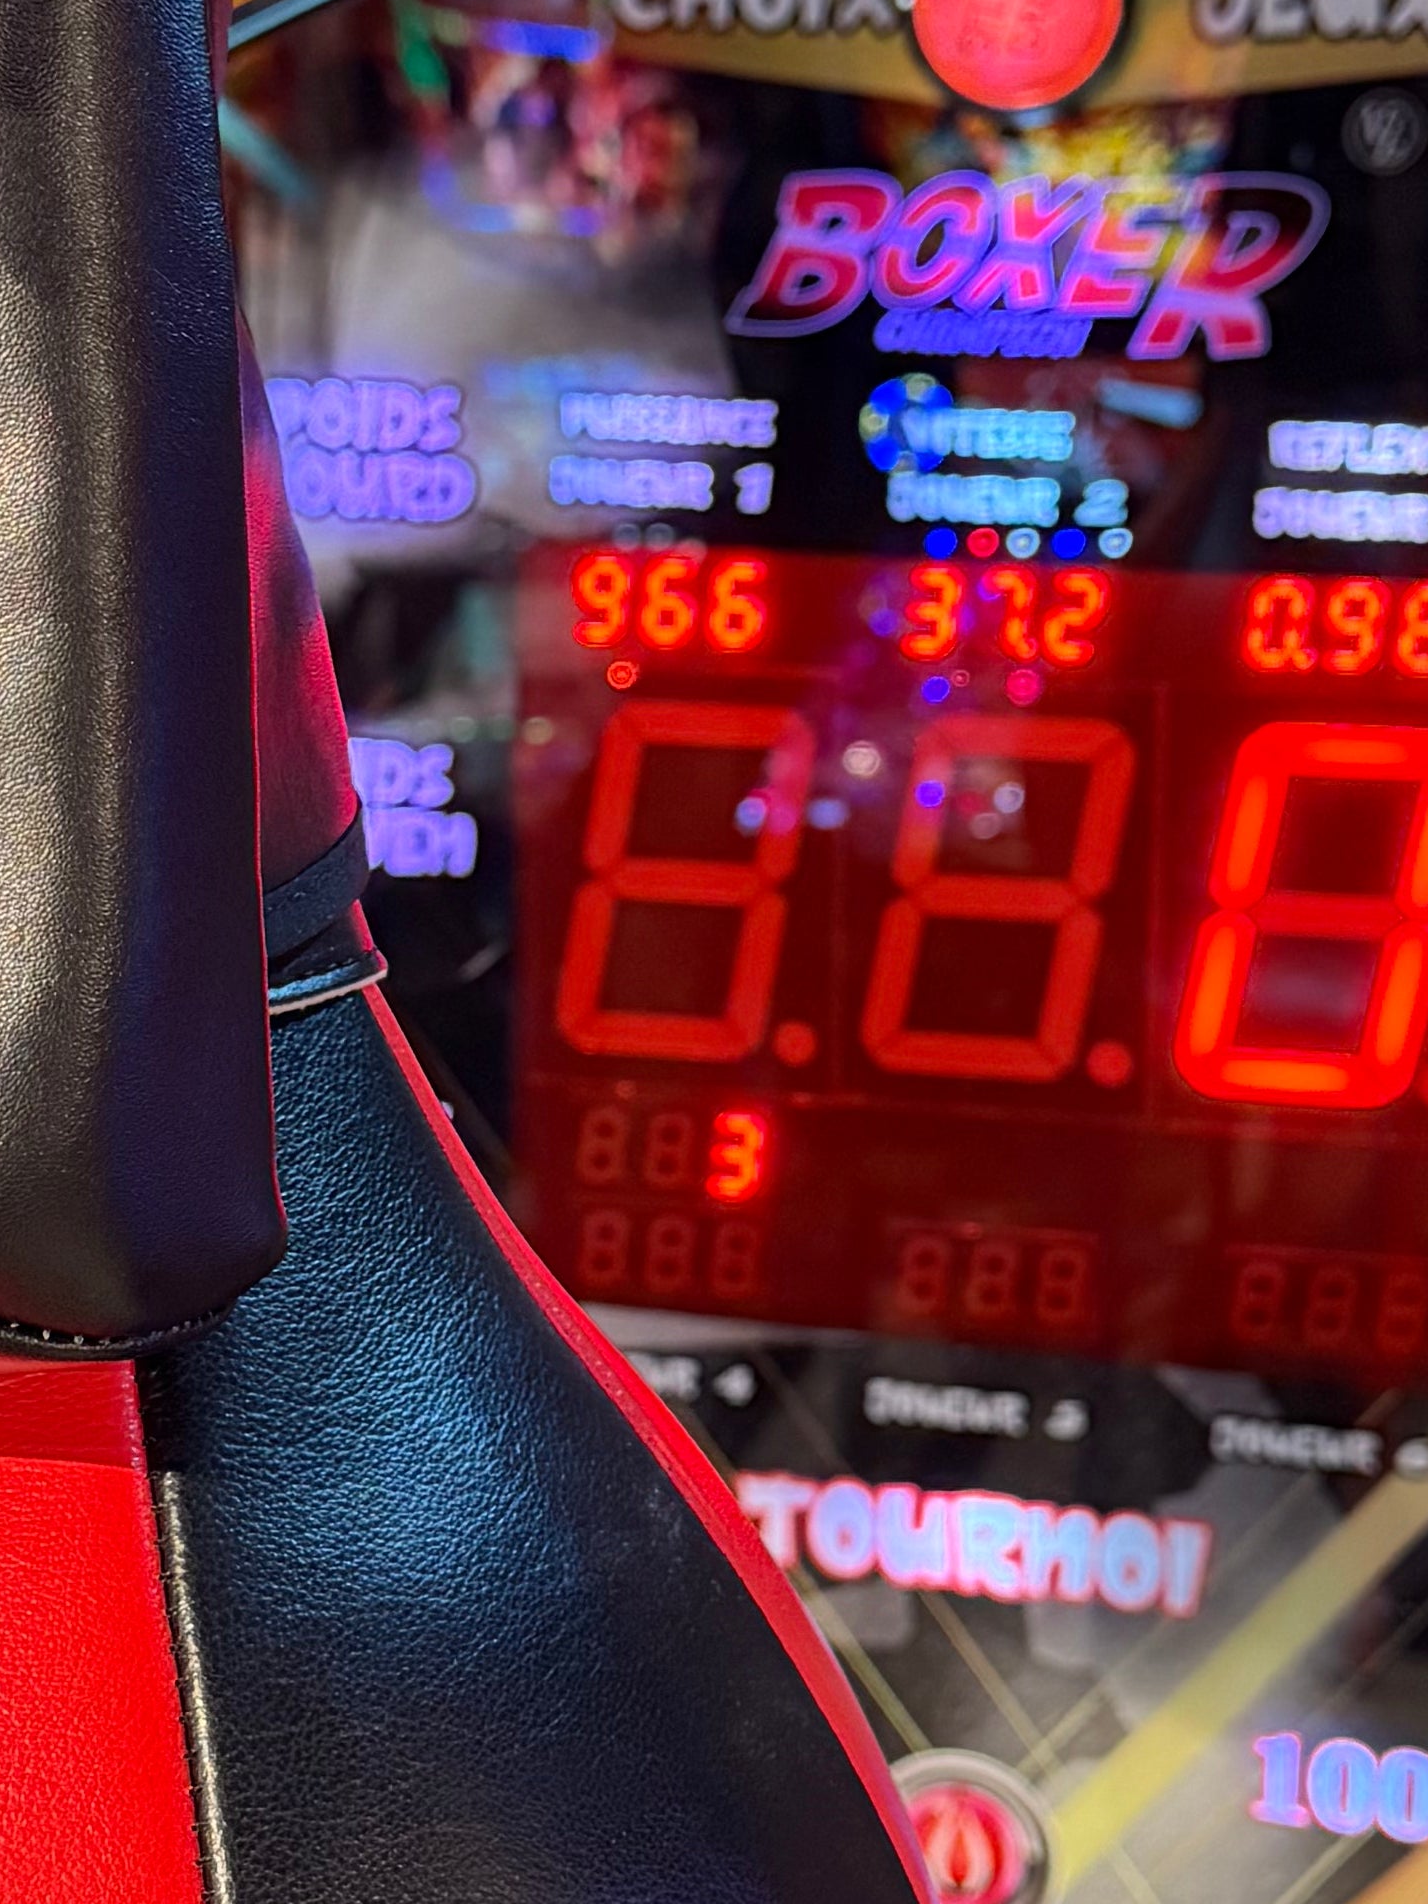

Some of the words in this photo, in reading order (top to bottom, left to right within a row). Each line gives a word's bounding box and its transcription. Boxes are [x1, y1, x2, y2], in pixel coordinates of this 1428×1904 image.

[724, 169, 1331, 360] BOXER
[284, 446, 476, 522] OURD
[1074, 479, 1128, 527] 2
[572, 552, 769, 653] 966
[735, 1472, 1214, 1619] TOURNOI
